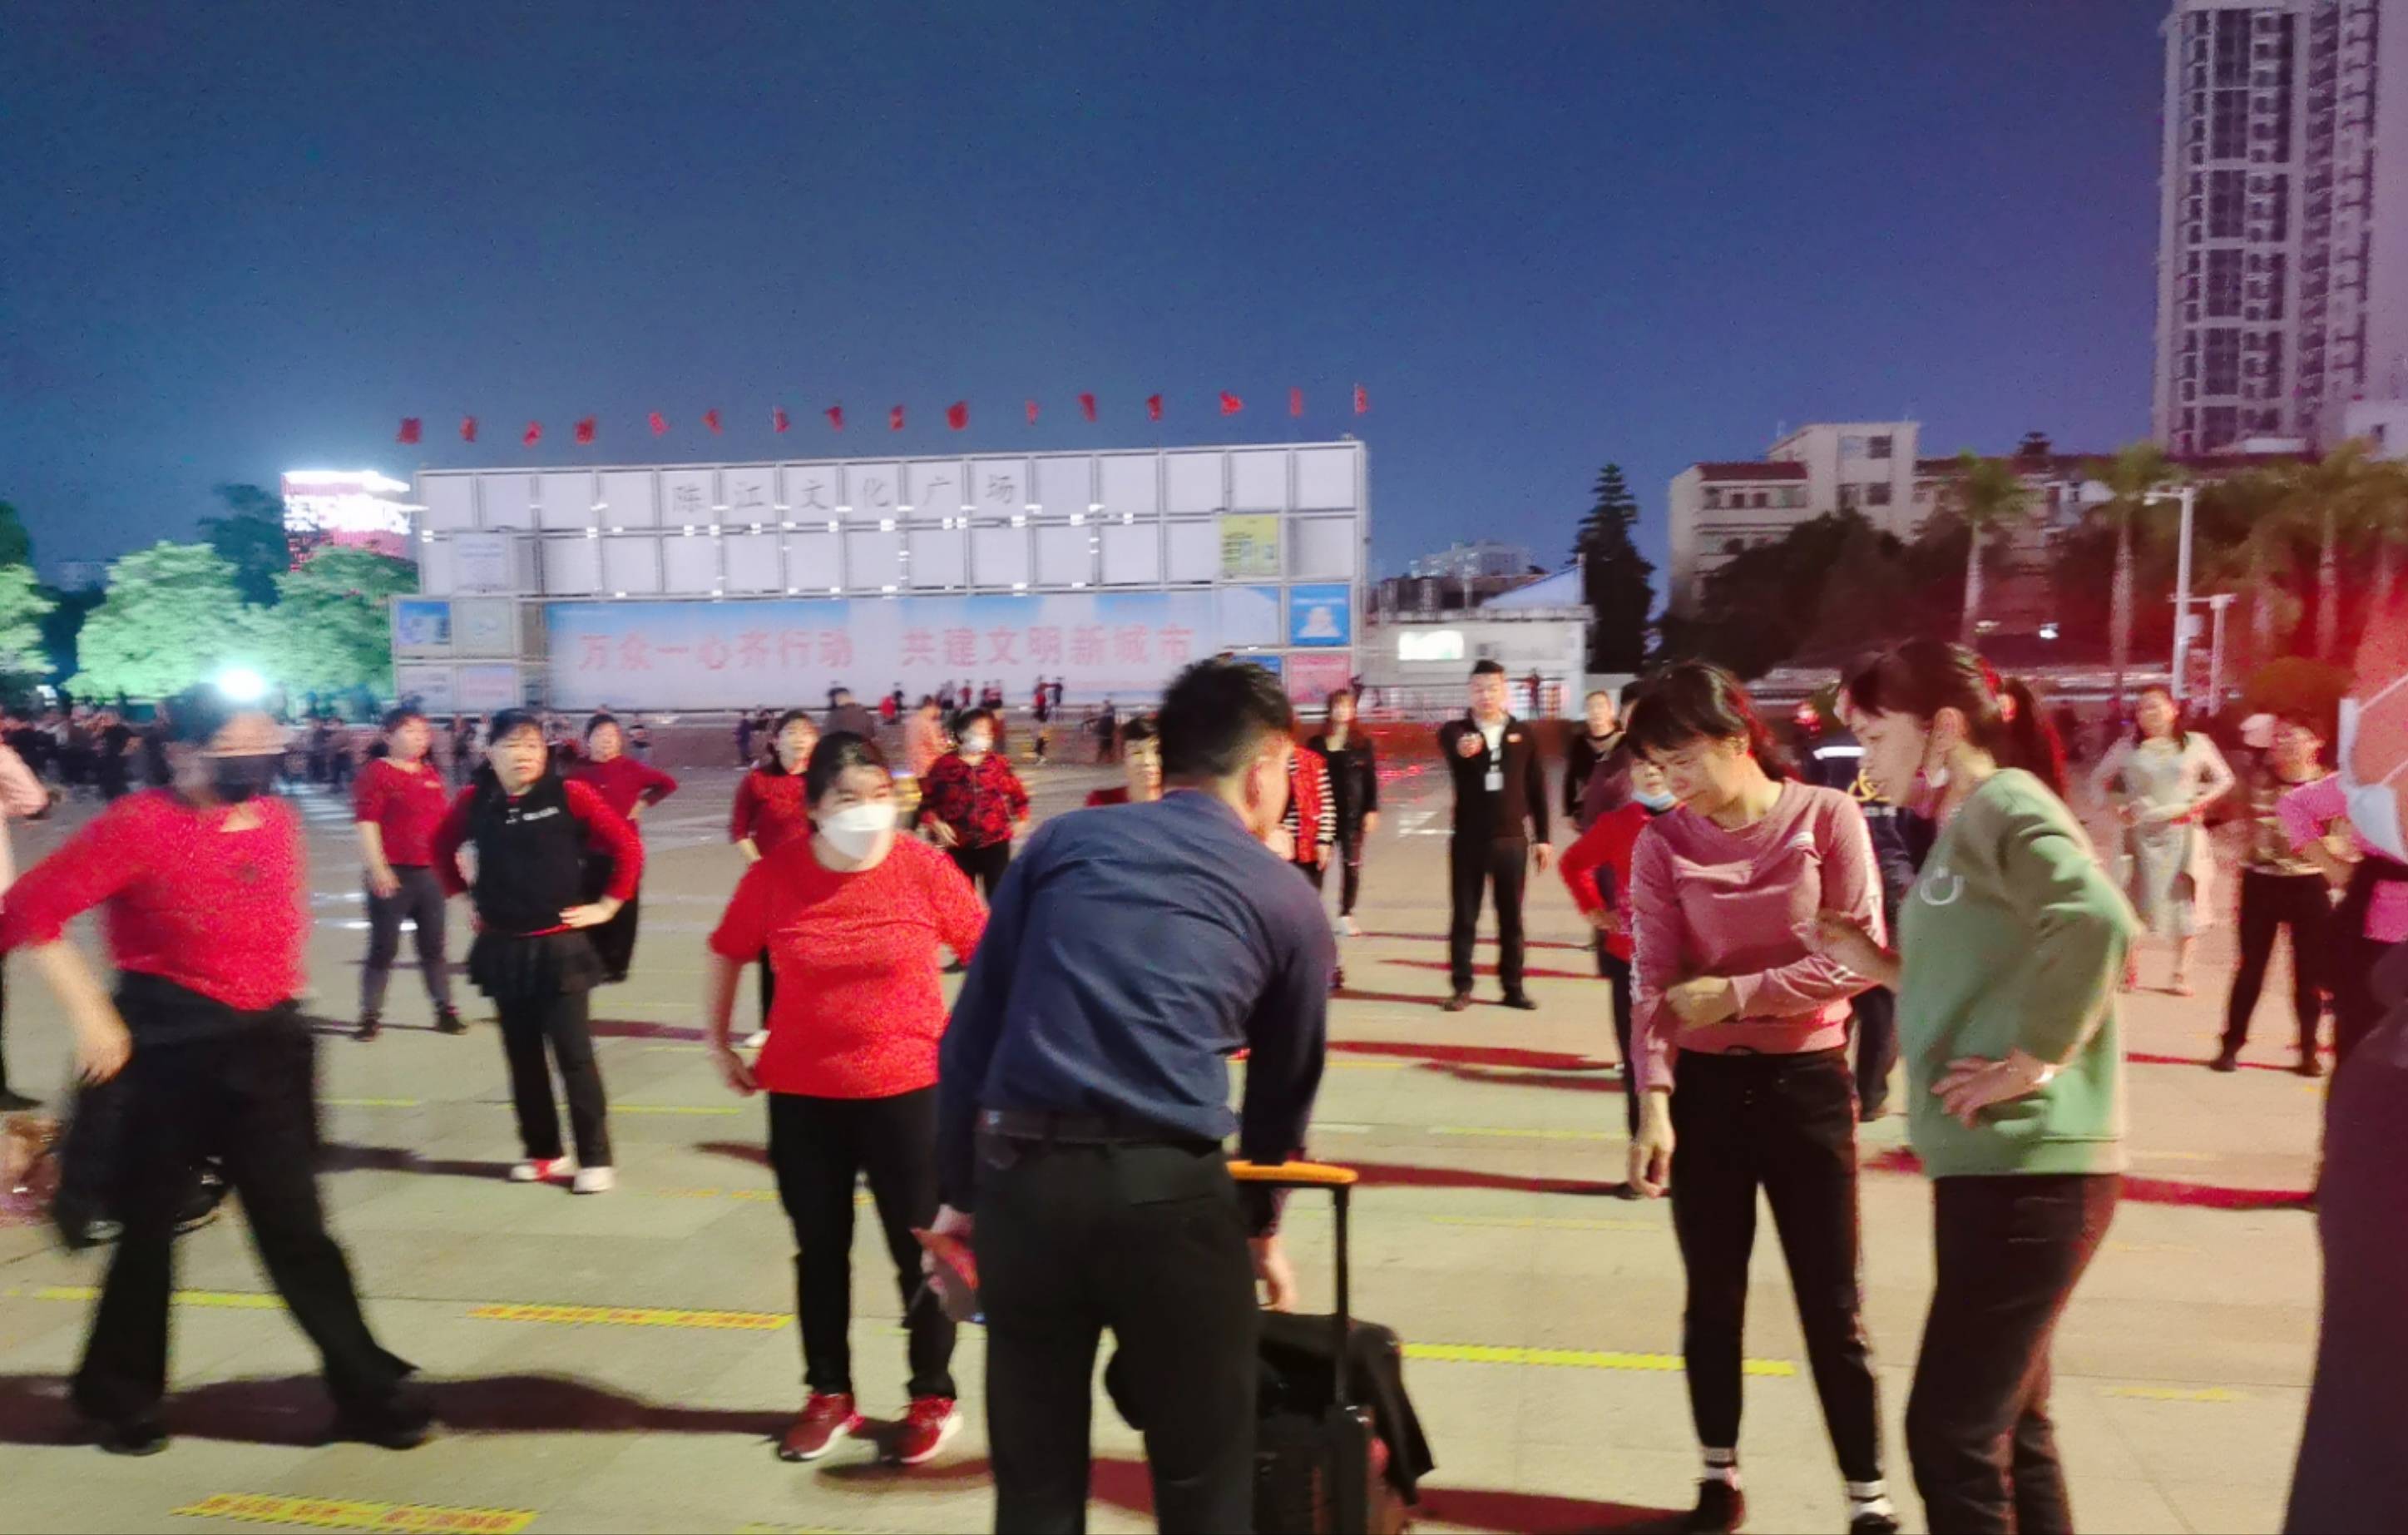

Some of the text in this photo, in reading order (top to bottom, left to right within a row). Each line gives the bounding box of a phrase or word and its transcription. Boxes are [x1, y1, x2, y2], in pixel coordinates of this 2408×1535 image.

[578, 623, 1194, 672] 万众一心齐行动 共建文明新城市
